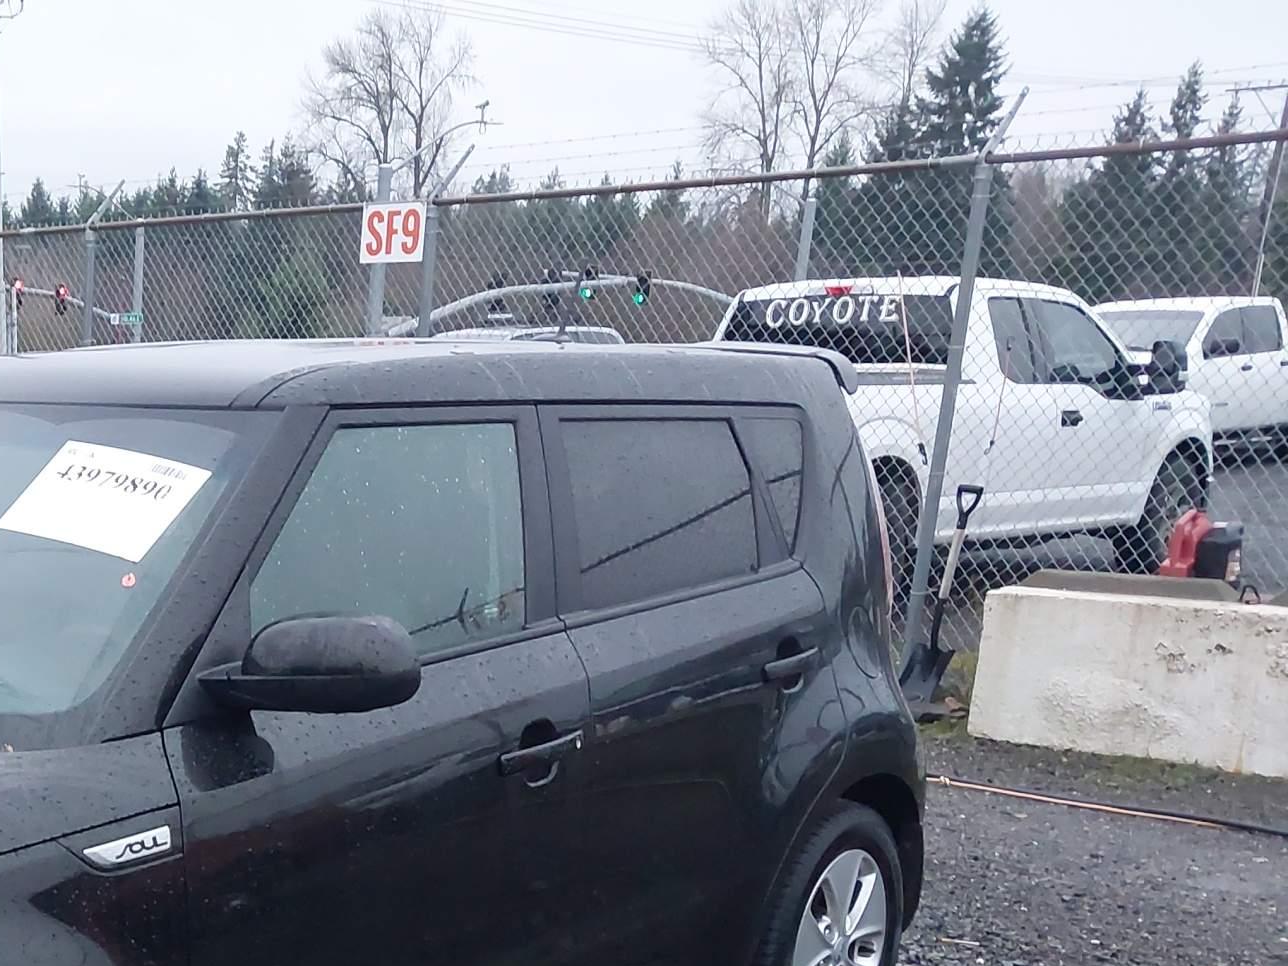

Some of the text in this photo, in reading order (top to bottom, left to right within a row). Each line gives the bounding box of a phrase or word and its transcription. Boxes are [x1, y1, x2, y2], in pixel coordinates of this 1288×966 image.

[365, 208, 421, 257] SF9
[765, 295, 902, 329] COYOTE
[56, 463, 173, 500] 43979890
